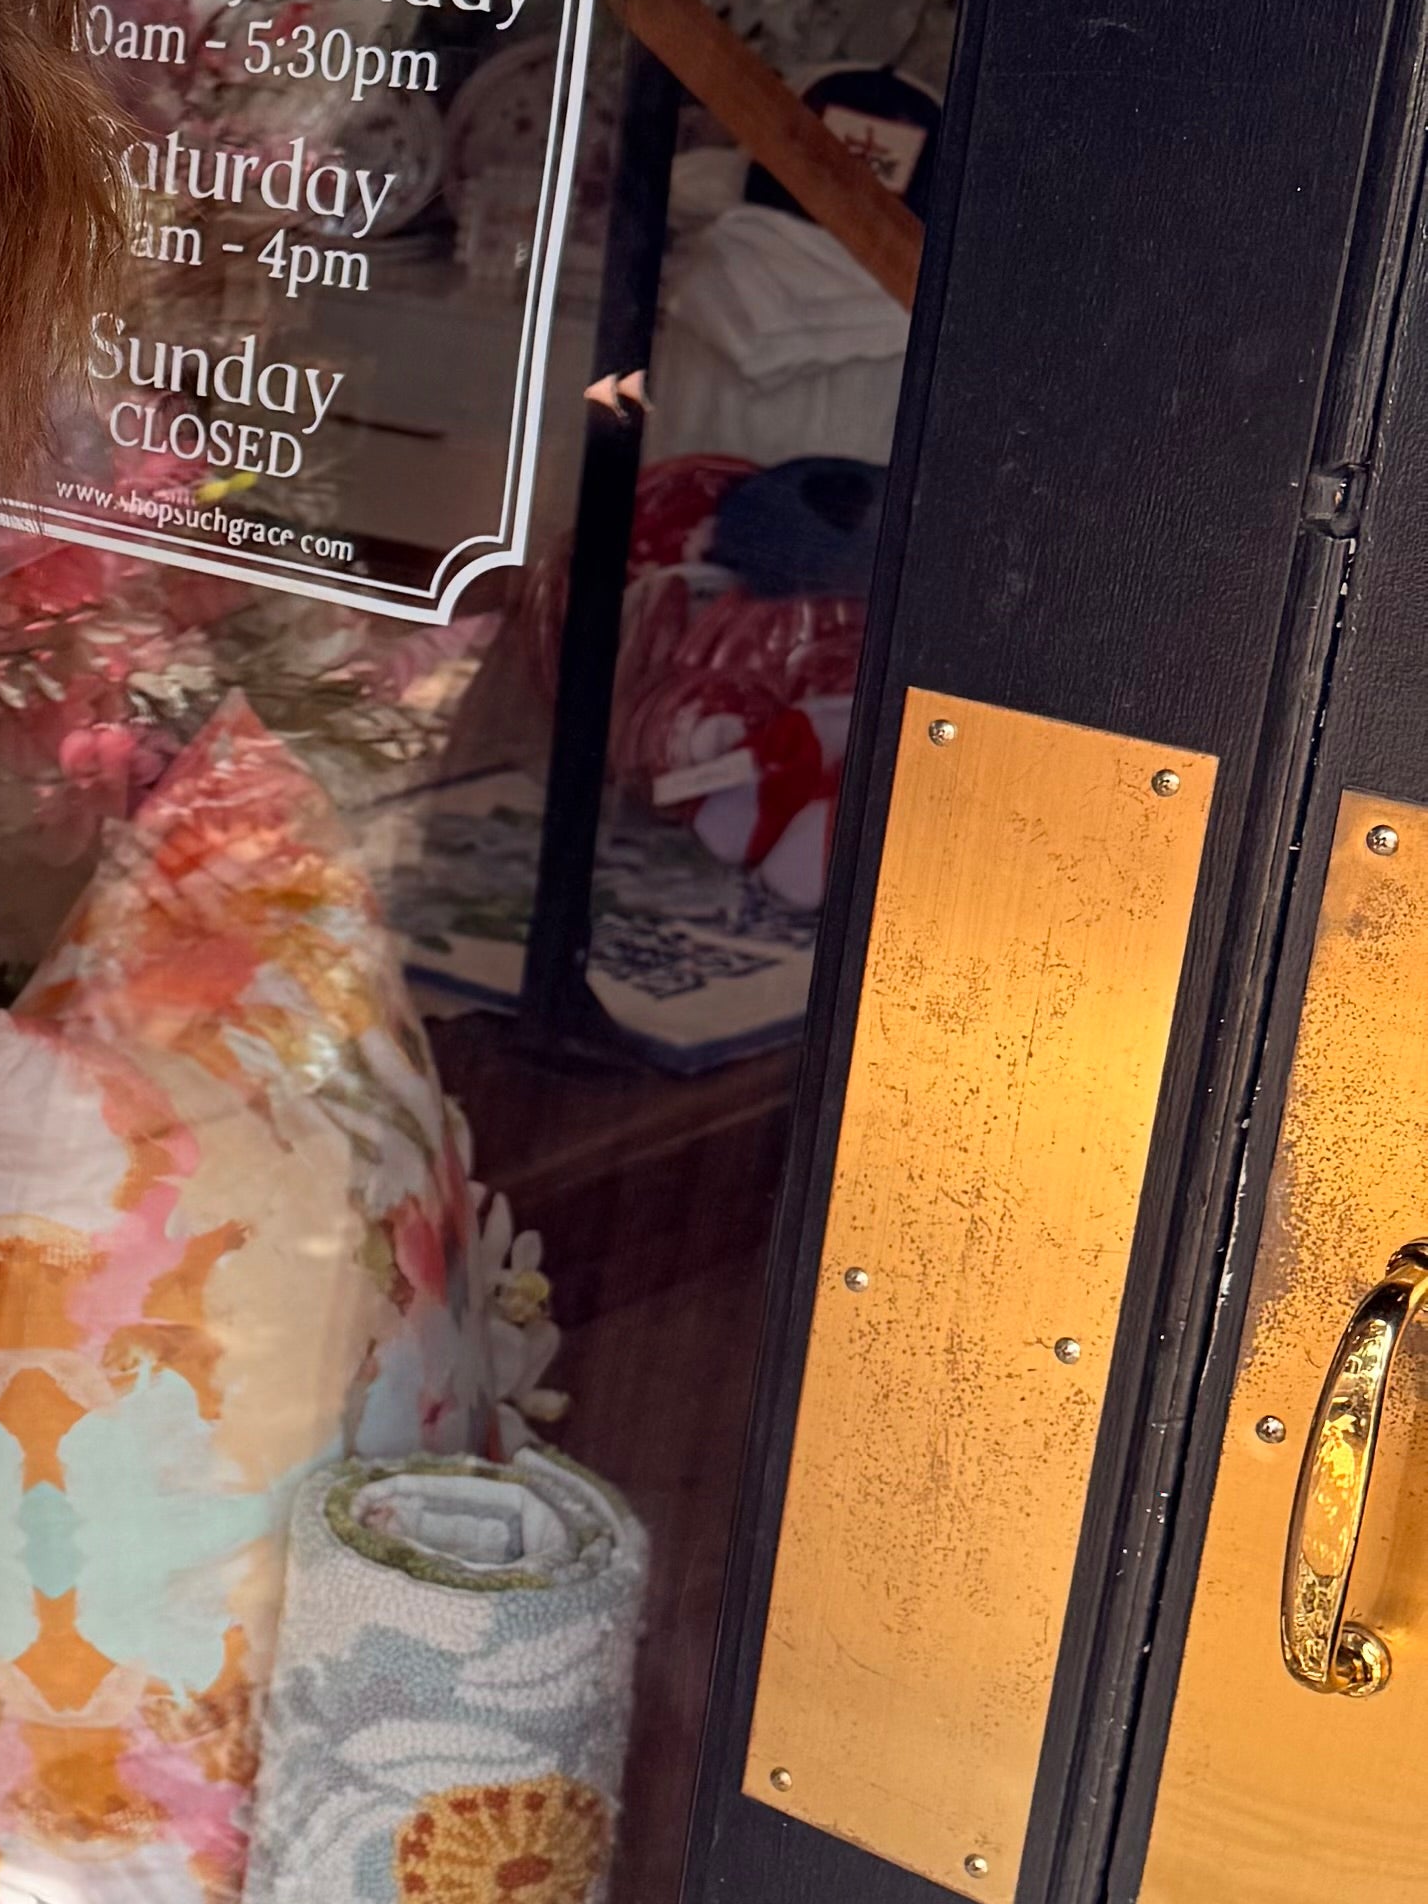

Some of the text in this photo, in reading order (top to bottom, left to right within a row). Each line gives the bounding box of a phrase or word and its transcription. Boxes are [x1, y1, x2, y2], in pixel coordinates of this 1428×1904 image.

[243, 18, 441, 103] 5:30pm
[88, 115, 397, 239] aturday
[257, 228, 371, 298] 4pm
[87, 311, 345, 435] Sunday
[109, 401, 303, 479] CLOSED
